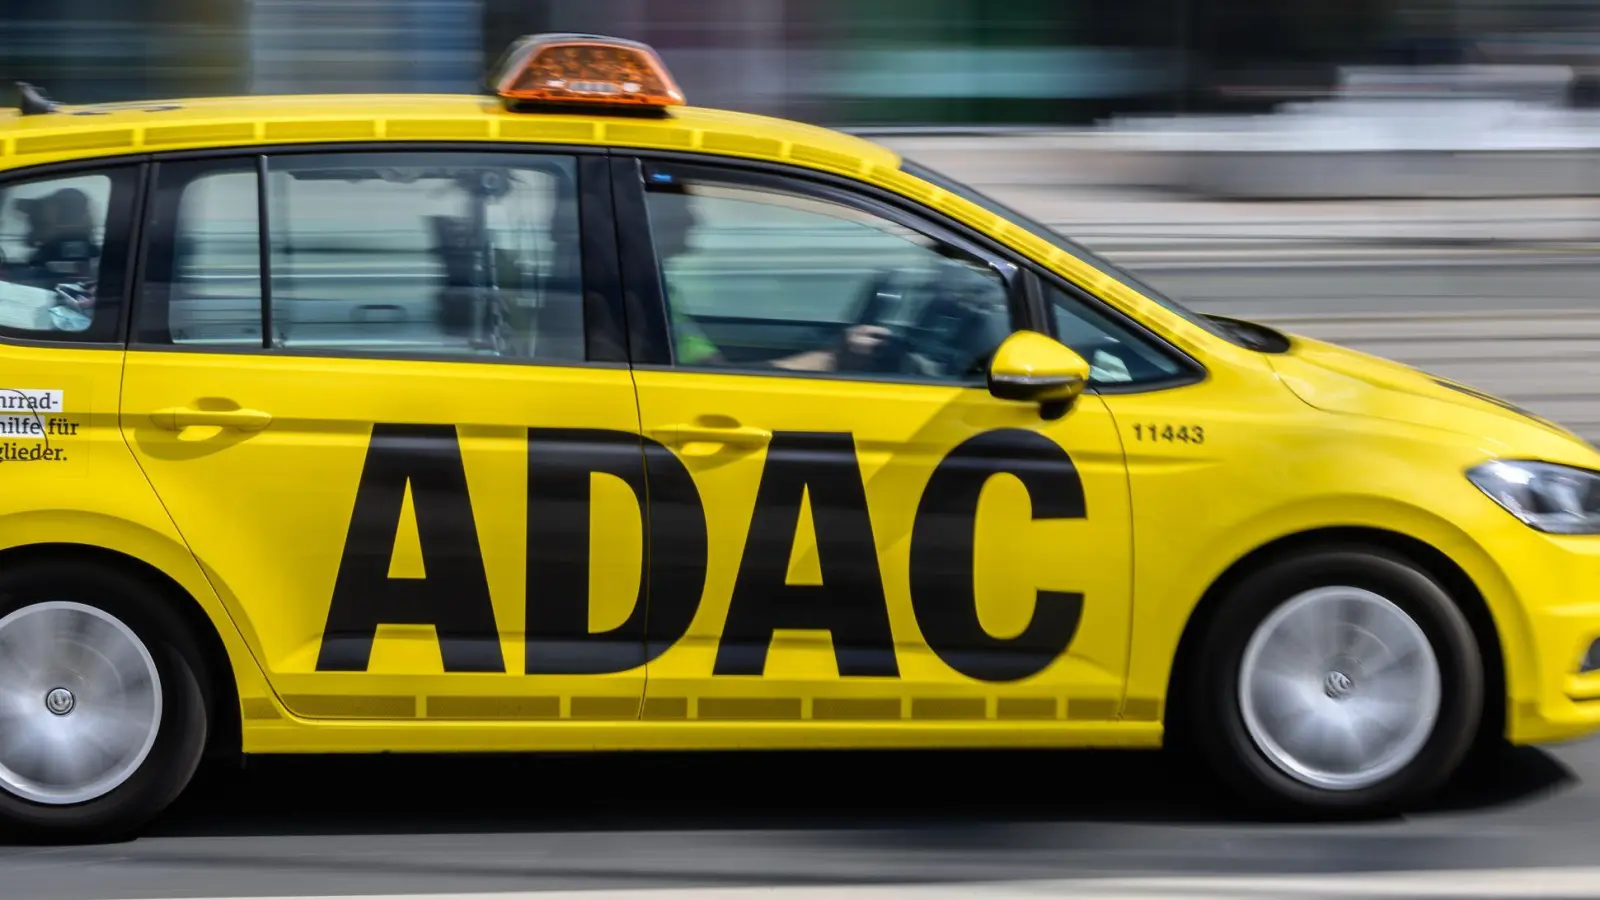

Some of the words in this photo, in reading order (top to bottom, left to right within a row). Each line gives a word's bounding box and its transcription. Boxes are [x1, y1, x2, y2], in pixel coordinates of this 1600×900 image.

[48, 418, 79, 435] für
[1133, 423, 1205, 444] 11443
[315, 424, 1088, 682] ADAC
